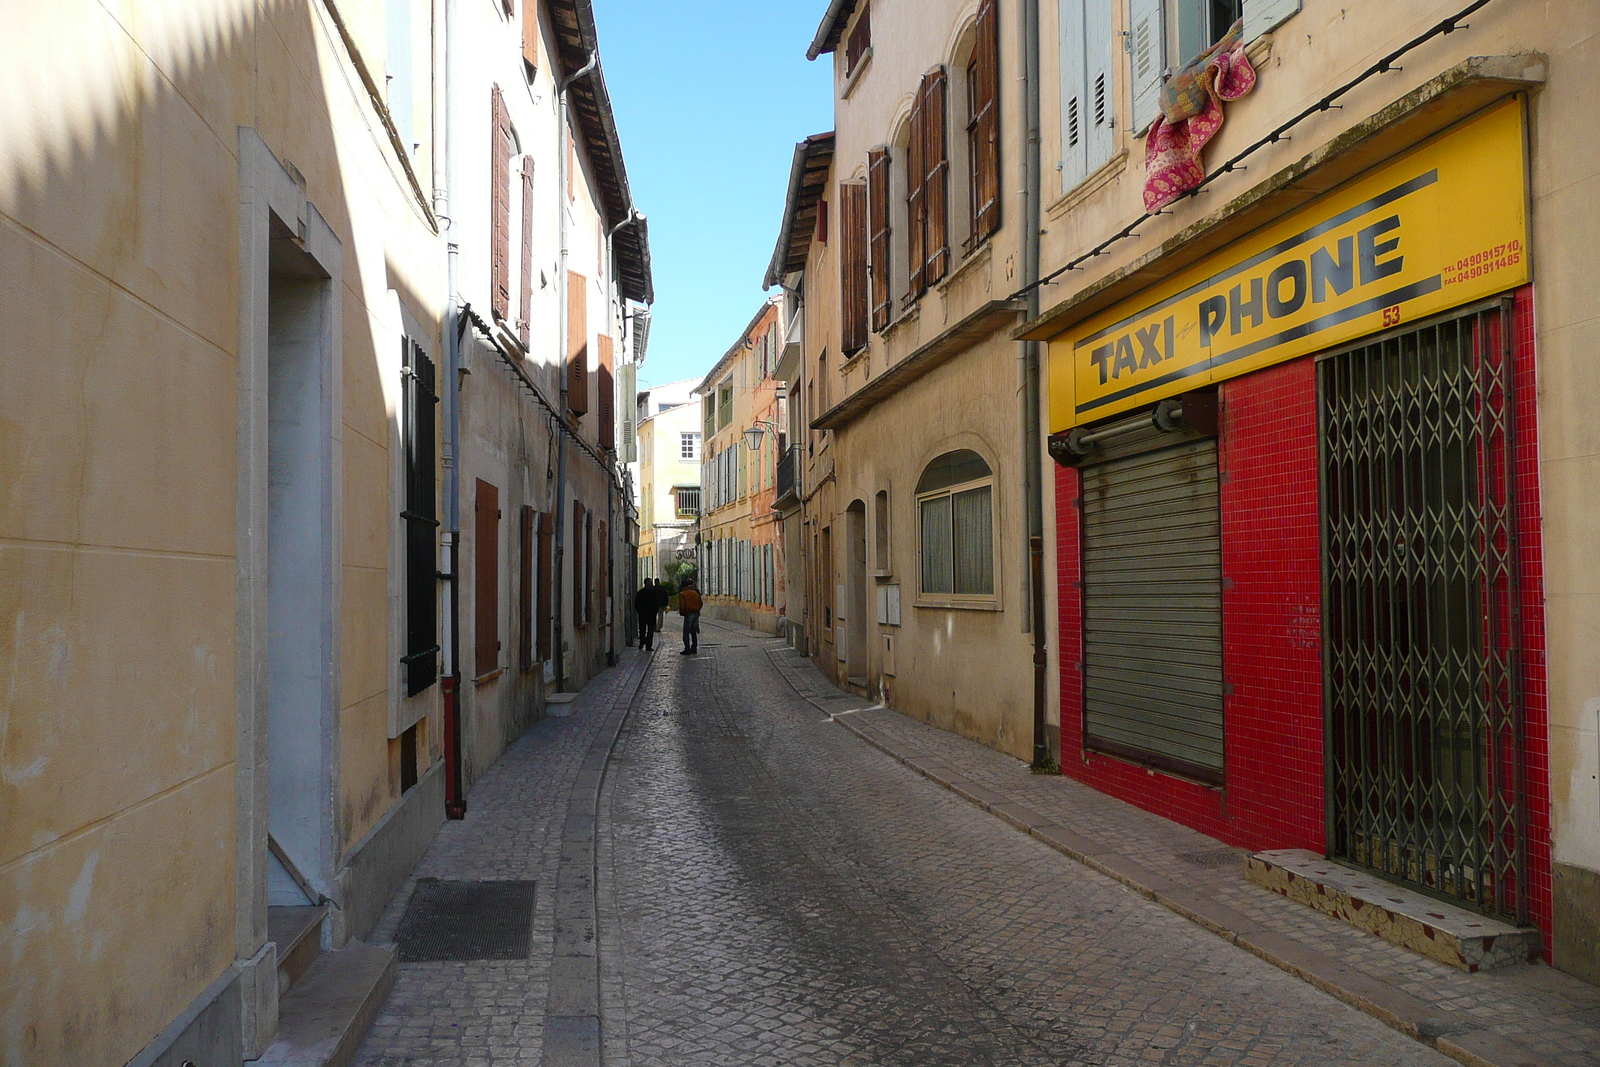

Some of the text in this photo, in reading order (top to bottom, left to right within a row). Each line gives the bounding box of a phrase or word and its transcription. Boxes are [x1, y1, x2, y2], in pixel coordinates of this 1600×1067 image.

[1444, 264, 1456, 274] TEL
[1444, 276, 1457, 286] FAX
[1090, 214, 1404, 385] TAXI PHONE
[1383, 305, 1400, 327] 53
